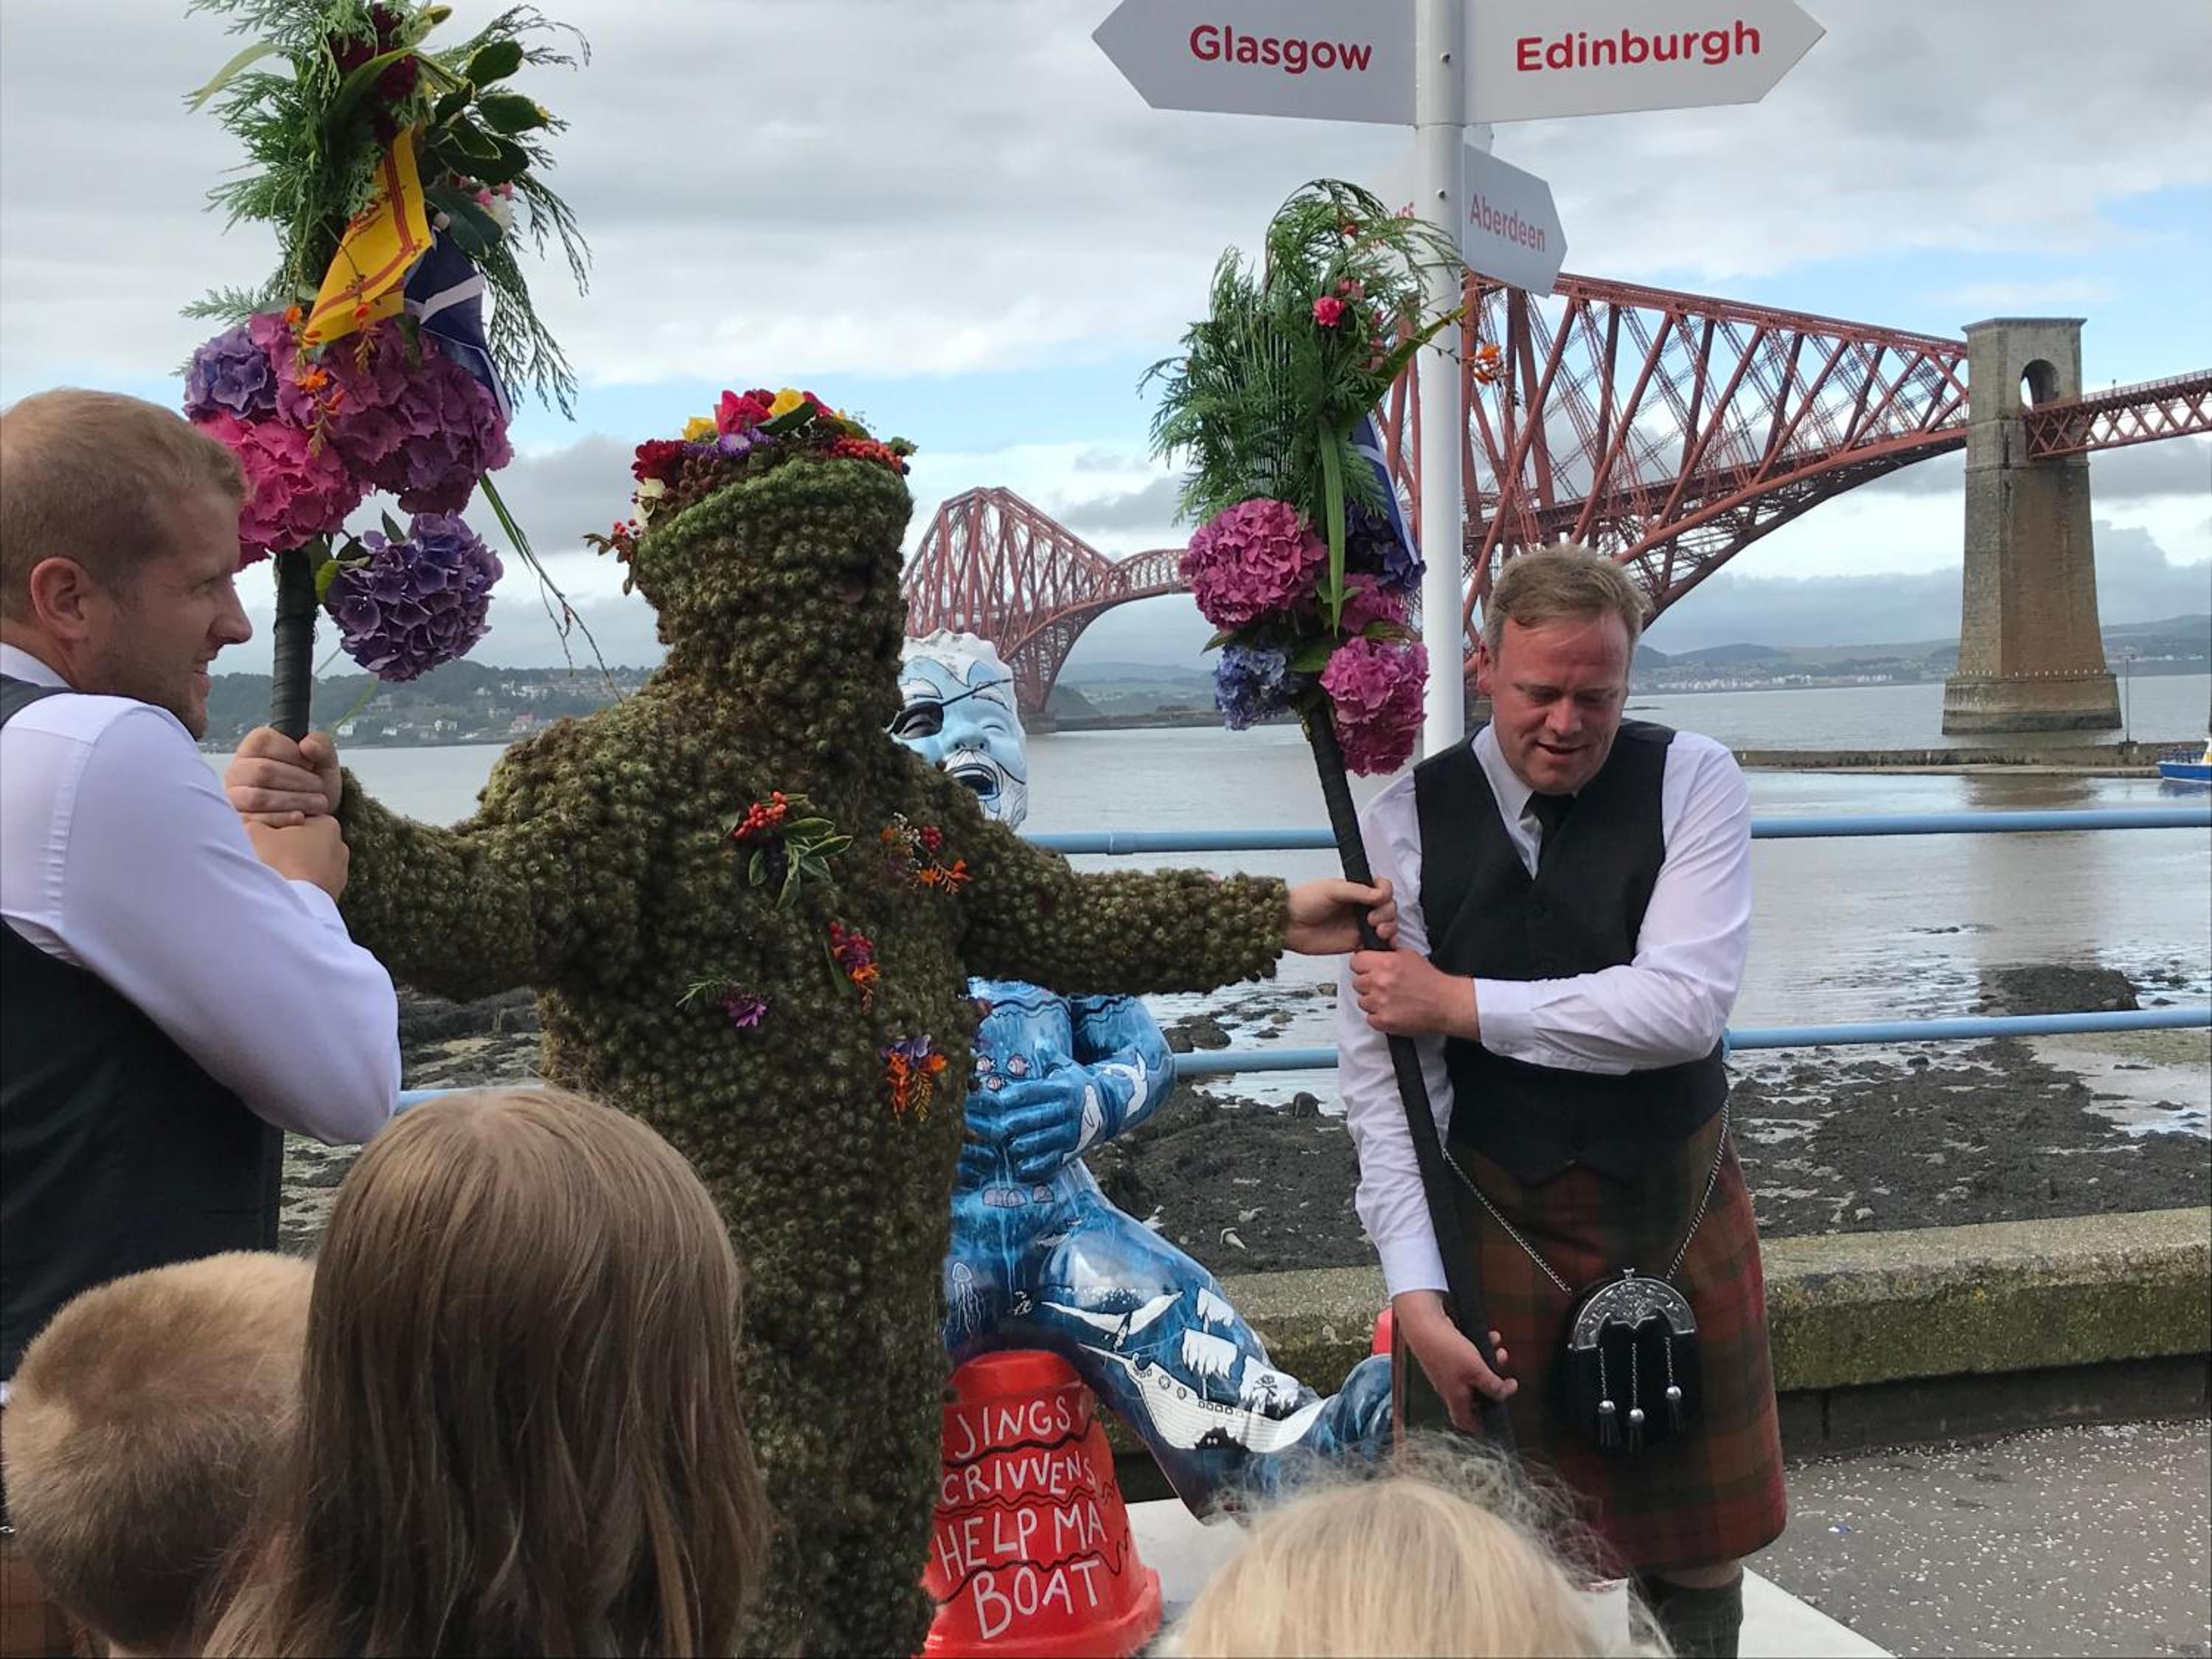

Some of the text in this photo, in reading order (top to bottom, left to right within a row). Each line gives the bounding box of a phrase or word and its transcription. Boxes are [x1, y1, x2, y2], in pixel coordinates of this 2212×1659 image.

[1189, 24, 1372, 74] Glasgow
[1517, 21, 1761, 72] Edinburgh
[1470, 193, 1545, 252] Aberdeen
[955, 1395, 1071, 1460] JINGS
[941, 1450, 1096, 1506] CRIVVENS
[936, 1498, 1108, 1581] HELP MA
[973, 1558, 1102, 1640] BOAT
